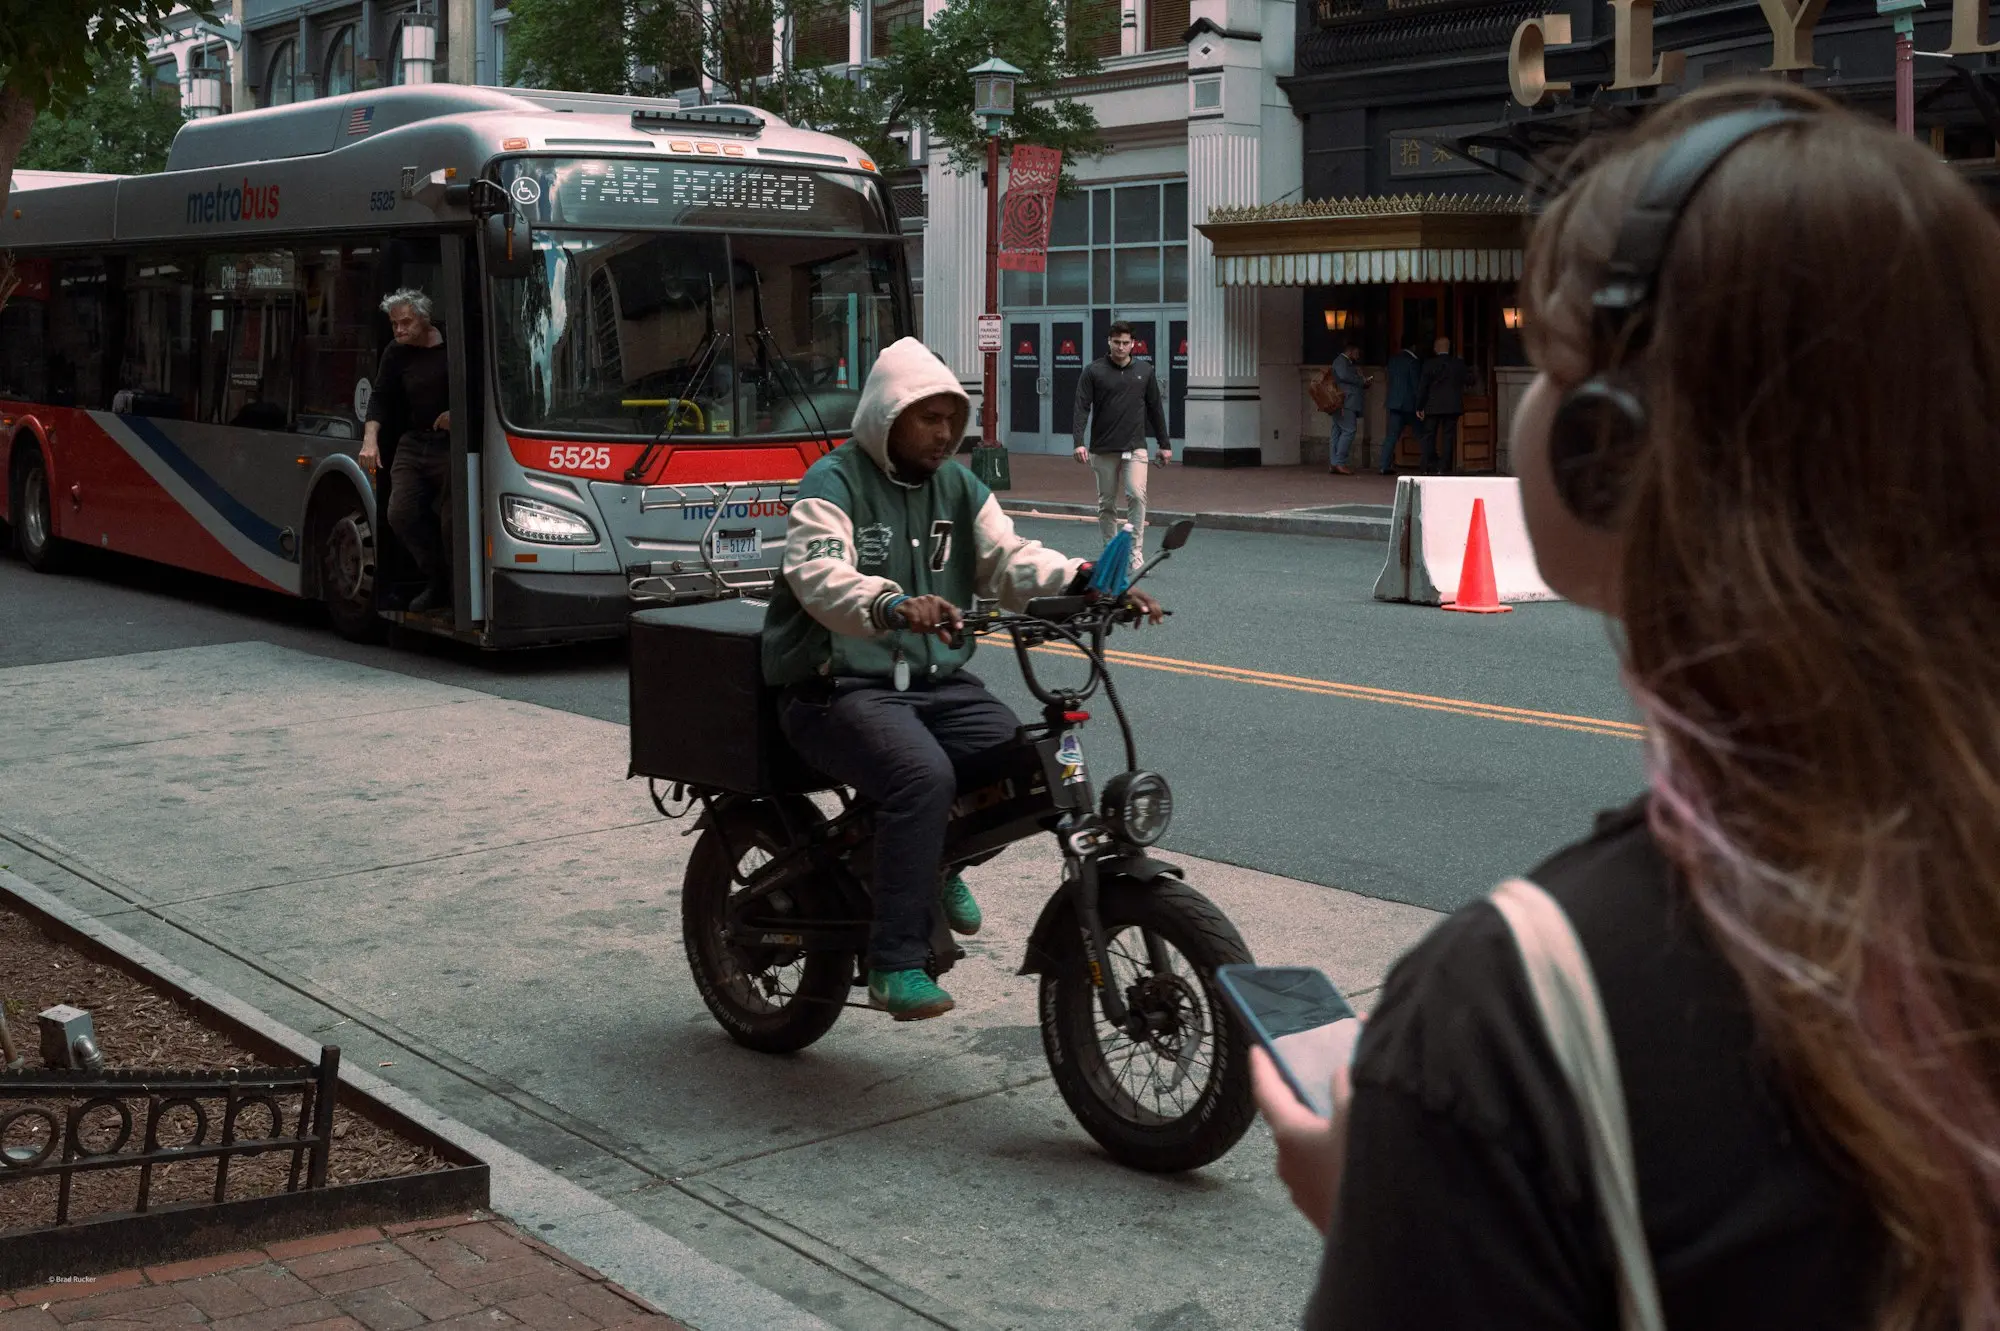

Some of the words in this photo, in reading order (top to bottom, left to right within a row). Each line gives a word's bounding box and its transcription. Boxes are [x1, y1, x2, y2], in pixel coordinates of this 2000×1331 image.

[1508, 0, 2000, 107] CLY
[187, 176, 280, 224] metrobus
[370, 191, 395, 211] 5525
[580, 164, 659, 204] FARE
[673, 169, 815, 211] REQUIRED
[548, 446, 611, 469] 5525
[730, 538, 756, 553] 51271
[807, 536, 845, 561] 28
[929, 520, 954, 572] 7
